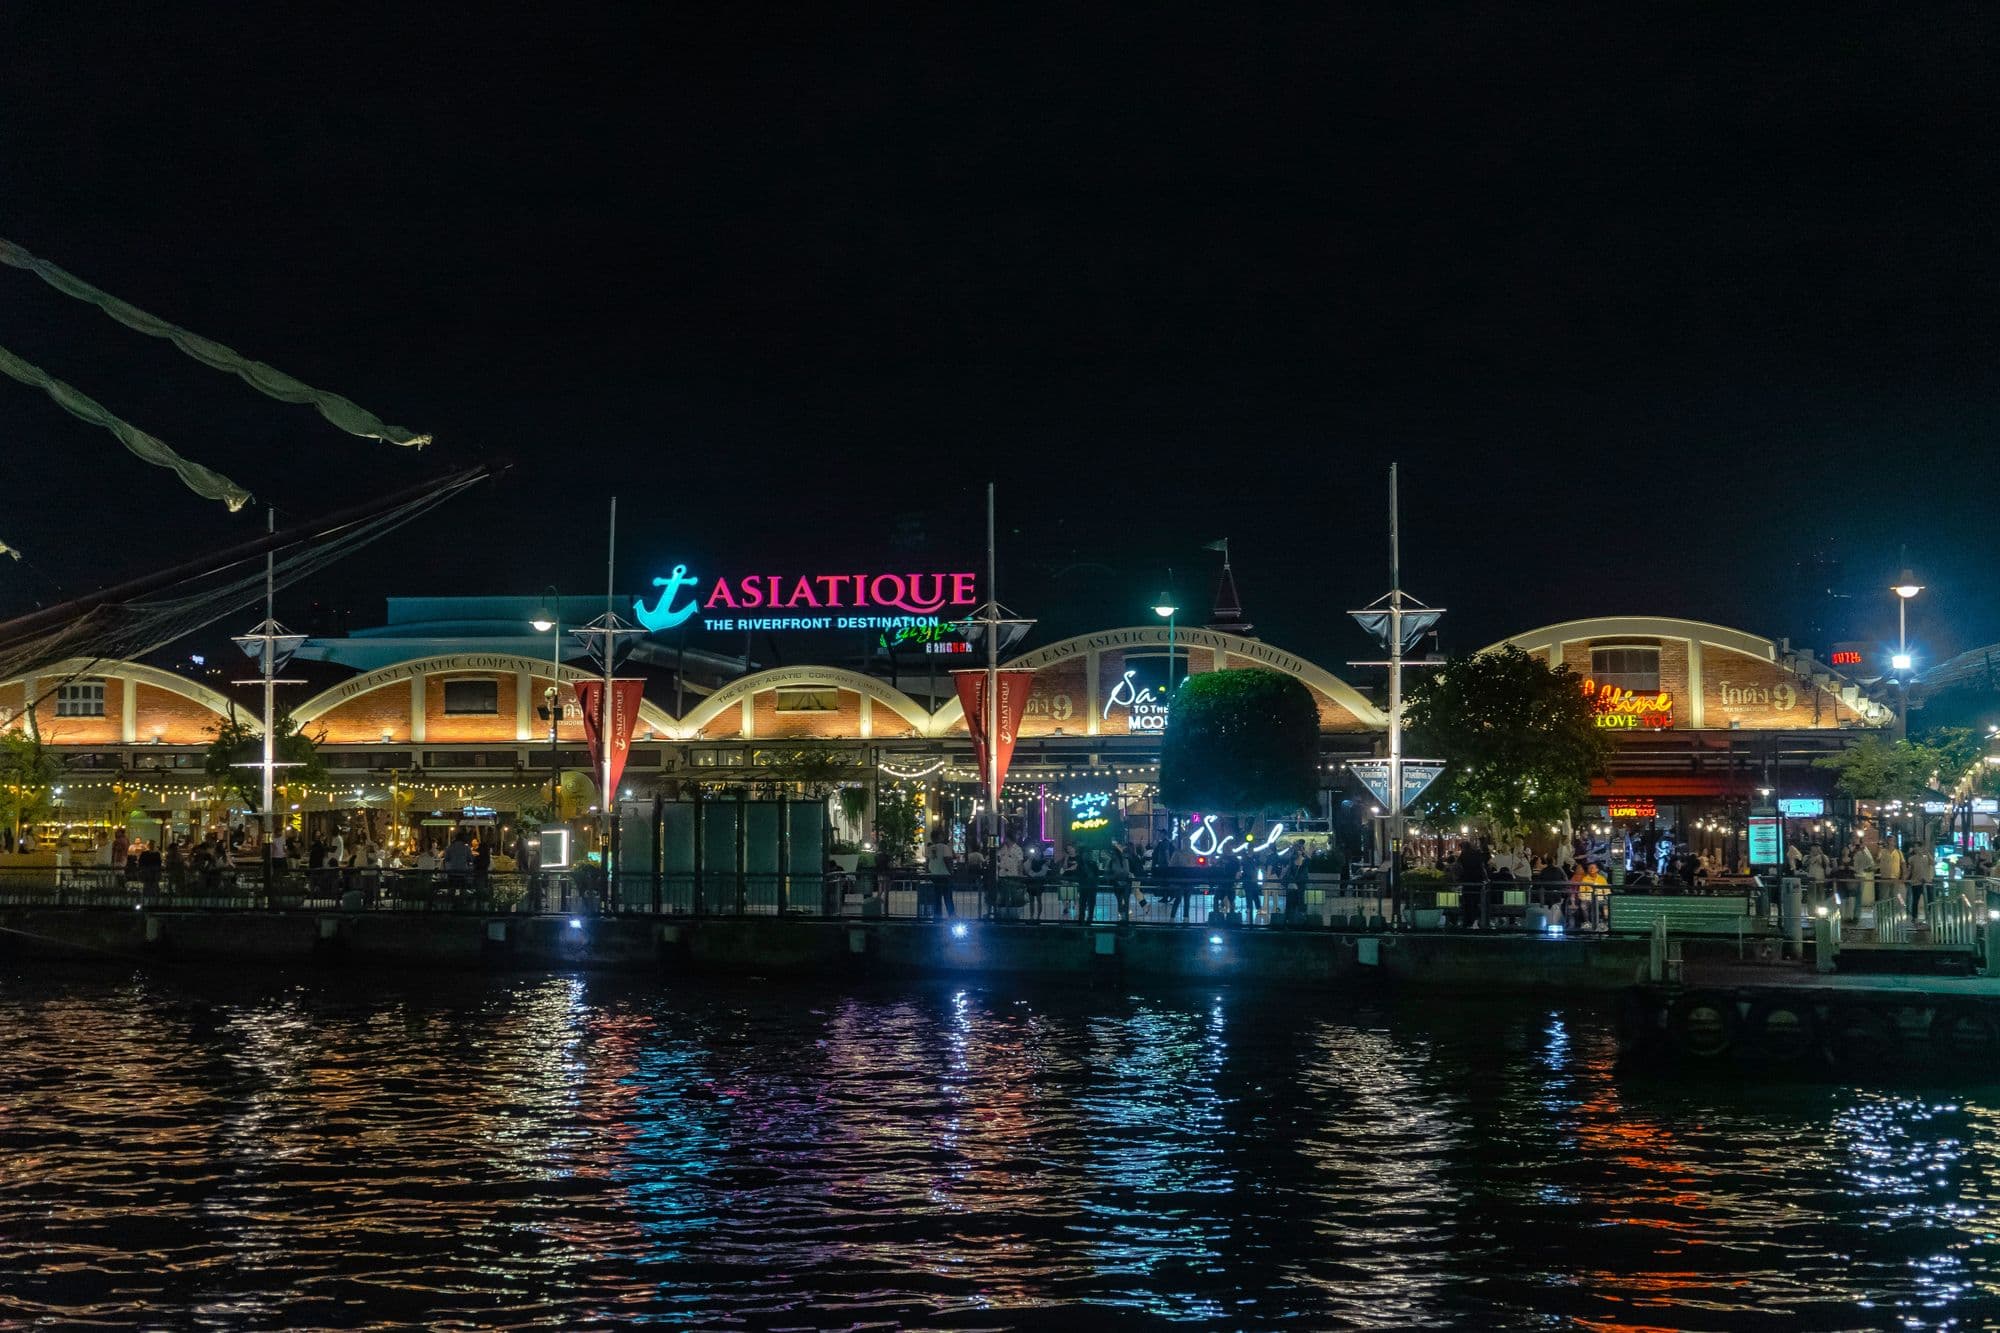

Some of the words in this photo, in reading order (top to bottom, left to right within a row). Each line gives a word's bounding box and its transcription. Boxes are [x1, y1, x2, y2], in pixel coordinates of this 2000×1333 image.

[704, 573, 977, 614] ASIATIQUE
[704, 619, 734, 631] THE
[738, 618, 833, 630] RIVERFRONT
[838, 616, 940, 629] DESTINATION
[1042, 641, 1078, 661] EAST
[1086, 630, 1147, 649] ASIATIC
[1157, 630, 1229, 649] COMPANY
[1239, 642, 1303, 674] LIMITED
[341, 682, 363, 698] THE
[368, 668, 399, 689] EAST
[406, 656, 459, 678] ASIATIC
[467, 656, 536, 673] COMPANY
[718, 692, 736, 704] THE
[738, 680, 762, 693] EAST
[765, 672, 802, 685] ASIATIC
[808, 672, 854, 685] COMPANY
[857, 681, 893, 700] LIMITED
[1001, 681, 1010, 731] ASIATIQUE
[1053, 693, 1073, 721] 9
[1133, 705, 1149, 714] TO
[1150, 705, 1169, 714] THE
[1773, 683, 1797, 711] 9
[616, 690, 625, 737] ASIATIQUE
[1597, 714, 1638, 727] LOVE
[1643, 713, 1675, 727] YOU
